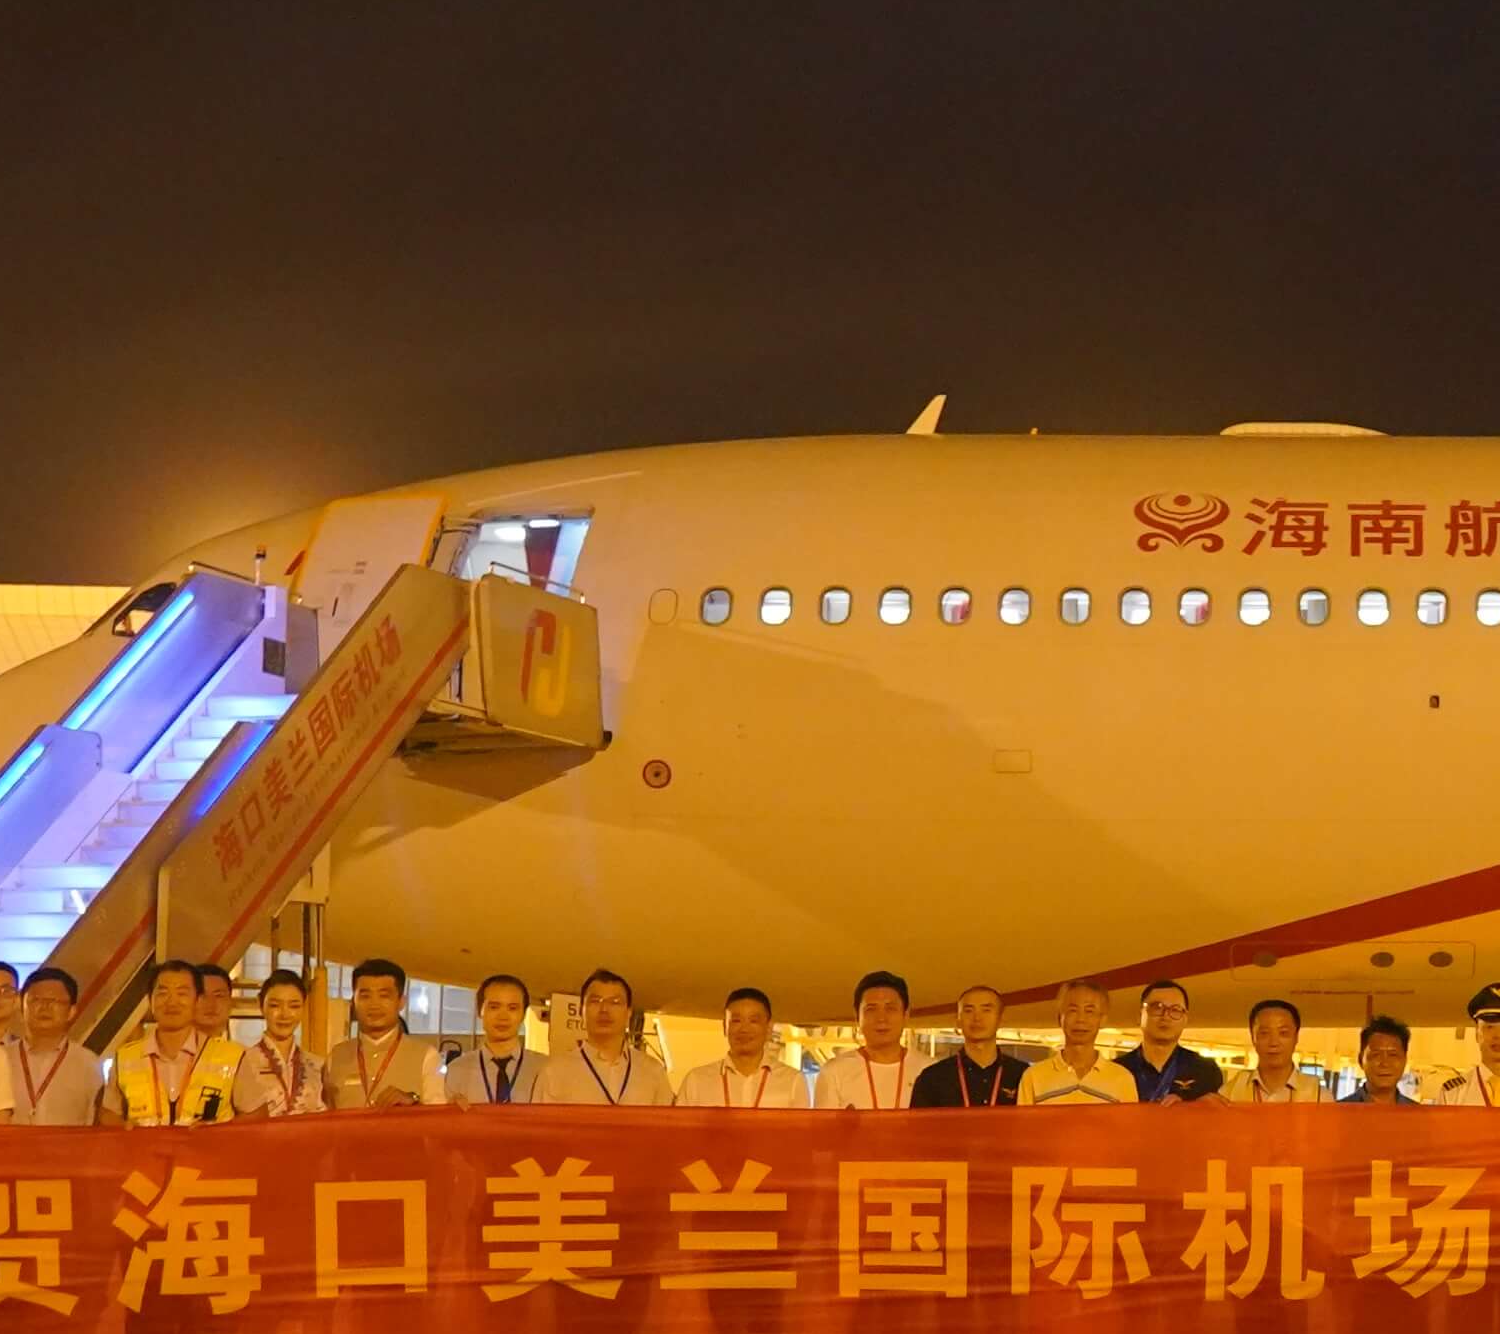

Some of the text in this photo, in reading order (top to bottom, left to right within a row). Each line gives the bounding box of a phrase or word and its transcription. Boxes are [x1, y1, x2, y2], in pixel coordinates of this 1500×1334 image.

[212, 613, 402, 882] 海口美兰国际机场
